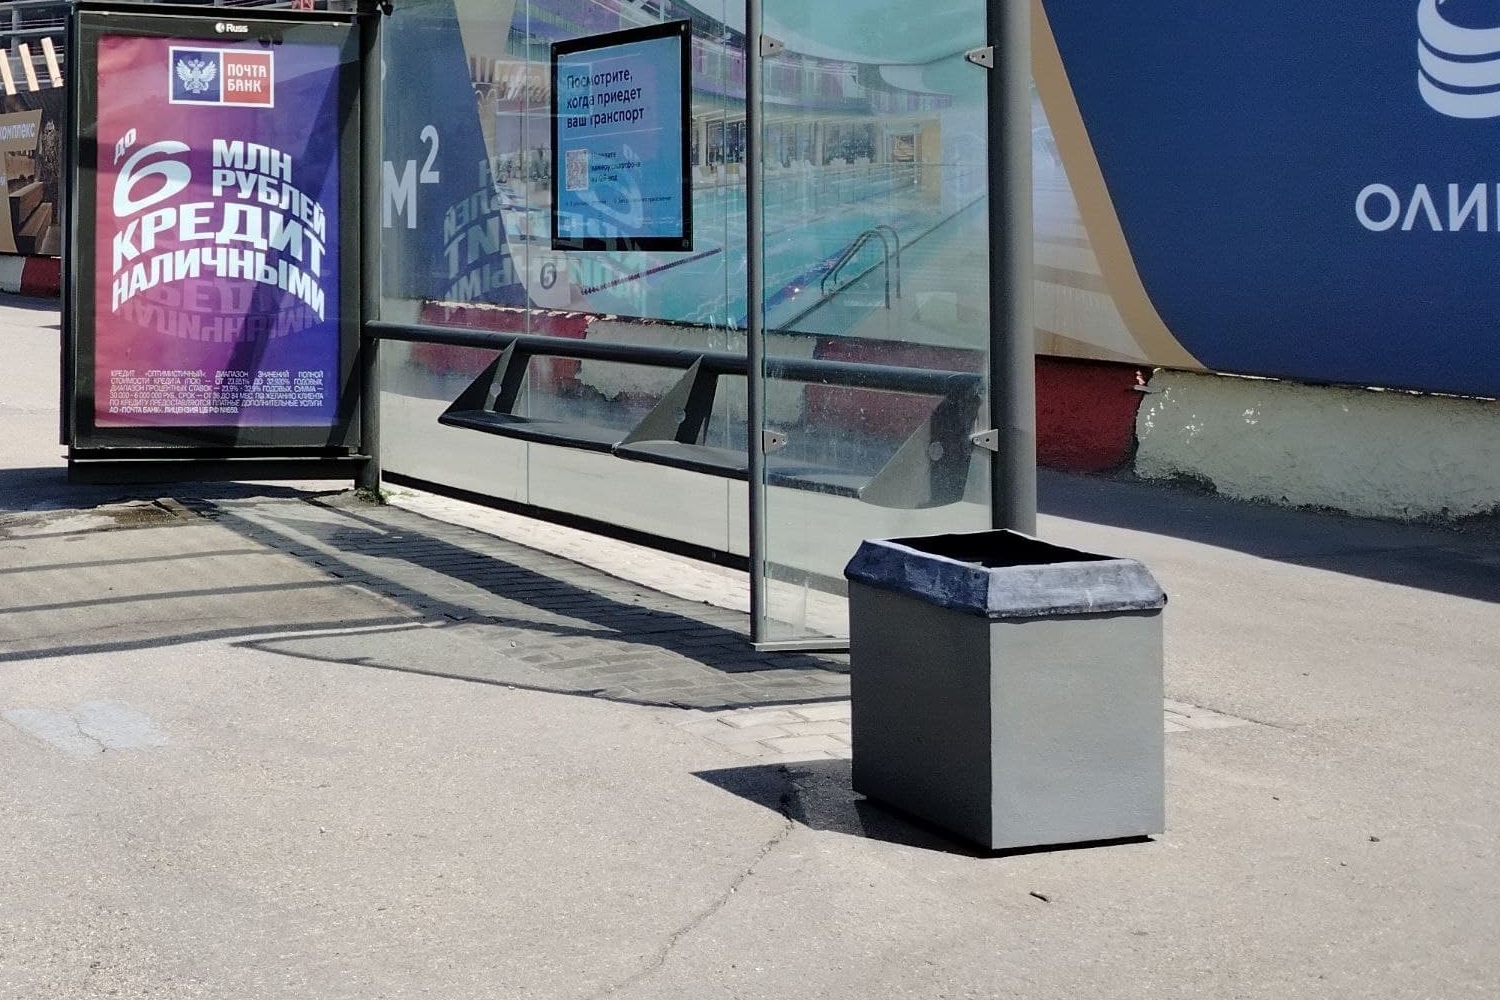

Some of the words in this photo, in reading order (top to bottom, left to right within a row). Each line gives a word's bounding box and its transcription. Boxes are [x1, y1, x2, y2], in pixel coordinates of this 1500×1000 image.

[225, 23, 249, 33] Russ
[227, 63, 267, 78] ПОЧТА
[227, 78, 262, 93] БАНК
[566, 68, 633, 89] Посмотрите,
[566, 97, 595, 110] когда
[597, 87, 642, 108] приедет
[567, 115, 587, 129] ваш
[590, 107, 645, 128] транспорт
[212, 138, 292, 184] МЛН
[113, 140, 192, 218] 6
[212, 168, 326, 244] РУБЛЕЙ
[1355, 182, 1500, 232] ОЛИ
[113, 201, 326, 278] КРЕДИТ
[112, 246, 325, 323] НАЛИЧНЫМИ
